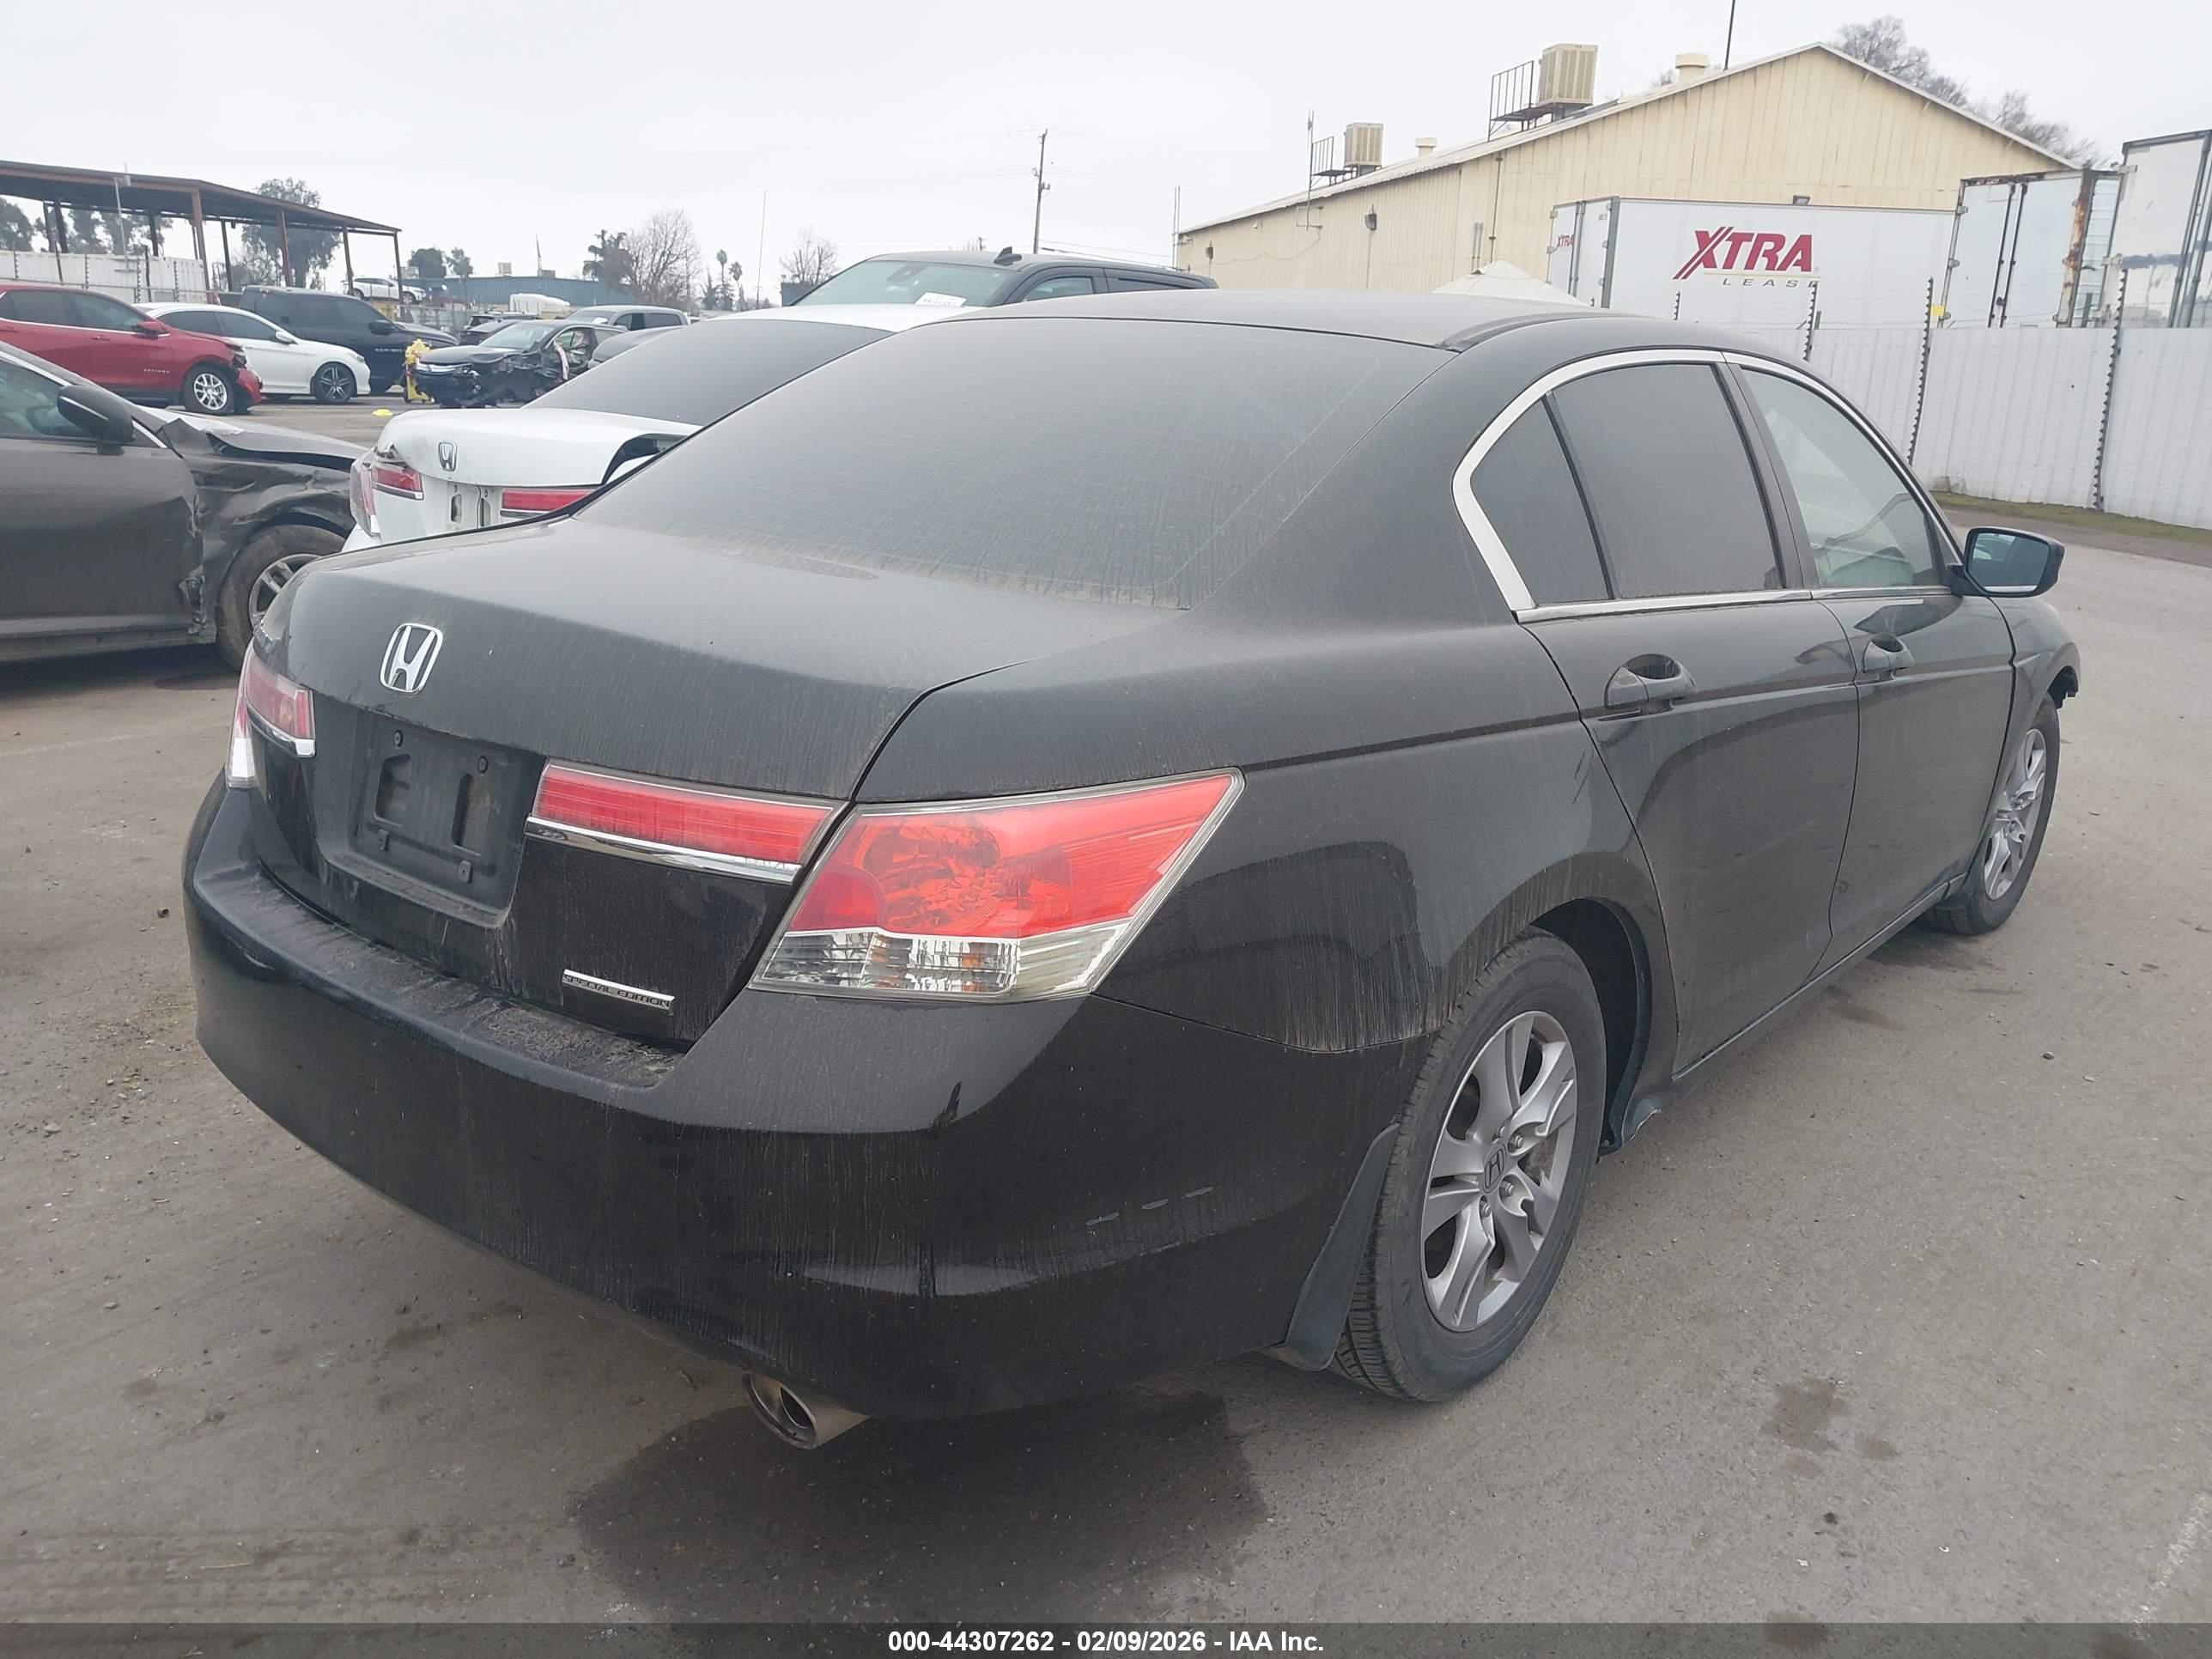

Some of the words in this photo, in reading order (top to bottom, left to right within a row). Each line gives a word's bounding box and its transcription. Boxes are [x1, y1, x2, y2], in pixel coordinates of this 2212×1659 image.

[1673, 226, 1813, 280] XTRA
[562, 975, 614, 994] SPECIAL
[617, 989, 671, 1009] EDITION
